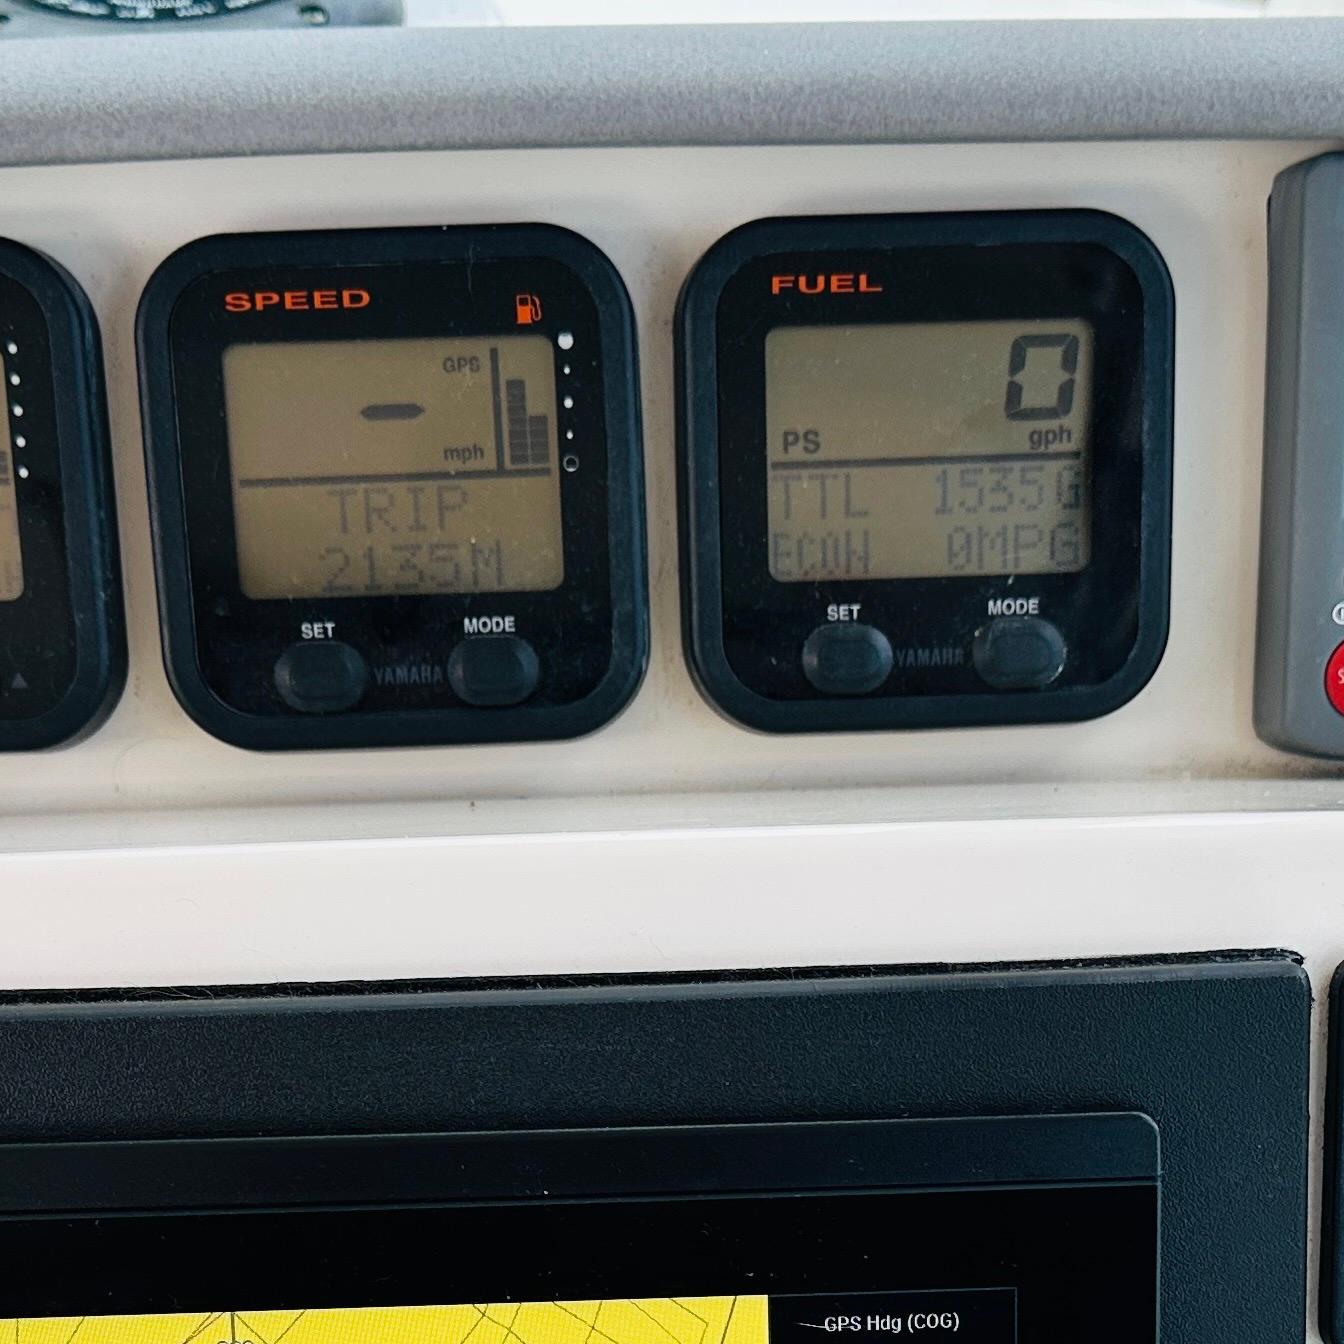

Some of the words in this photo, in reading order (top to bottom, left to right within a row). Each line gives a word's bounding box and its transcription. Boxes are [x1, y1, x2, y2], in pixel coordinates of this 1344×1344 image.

[771, 273, 883, 295] FUEL
[224, 289, 370, 312] SPEED
[442, 356, 481, 373] GPS
[1004, 334, 1080, 421] 0
[782, 431, 821, 454] PS
[1028, 427, 1072, 450] gph
[443, 443, 485, 462] mph
[772, 472, 868, 521] TTL
[327, 485, 468, 534] TRIP
[772, 528, 869, 577] ECON
[318, 540, 503, 593] 2135M
[827, 605, 861, 622] SET
[987, 599, 1040, 616] MODE
[301, 623, 335, 639] SET
[463, 616, 516, 634] MODE
[896, 647, 964, 667] YAMAHA
[373, 664, 443, 687] YAMAHA
[824, 1315, 861, 1333] GPS
[867, 1315, 902, 1333] Hdg
[907, 1312, 960, 1331] (COG)
